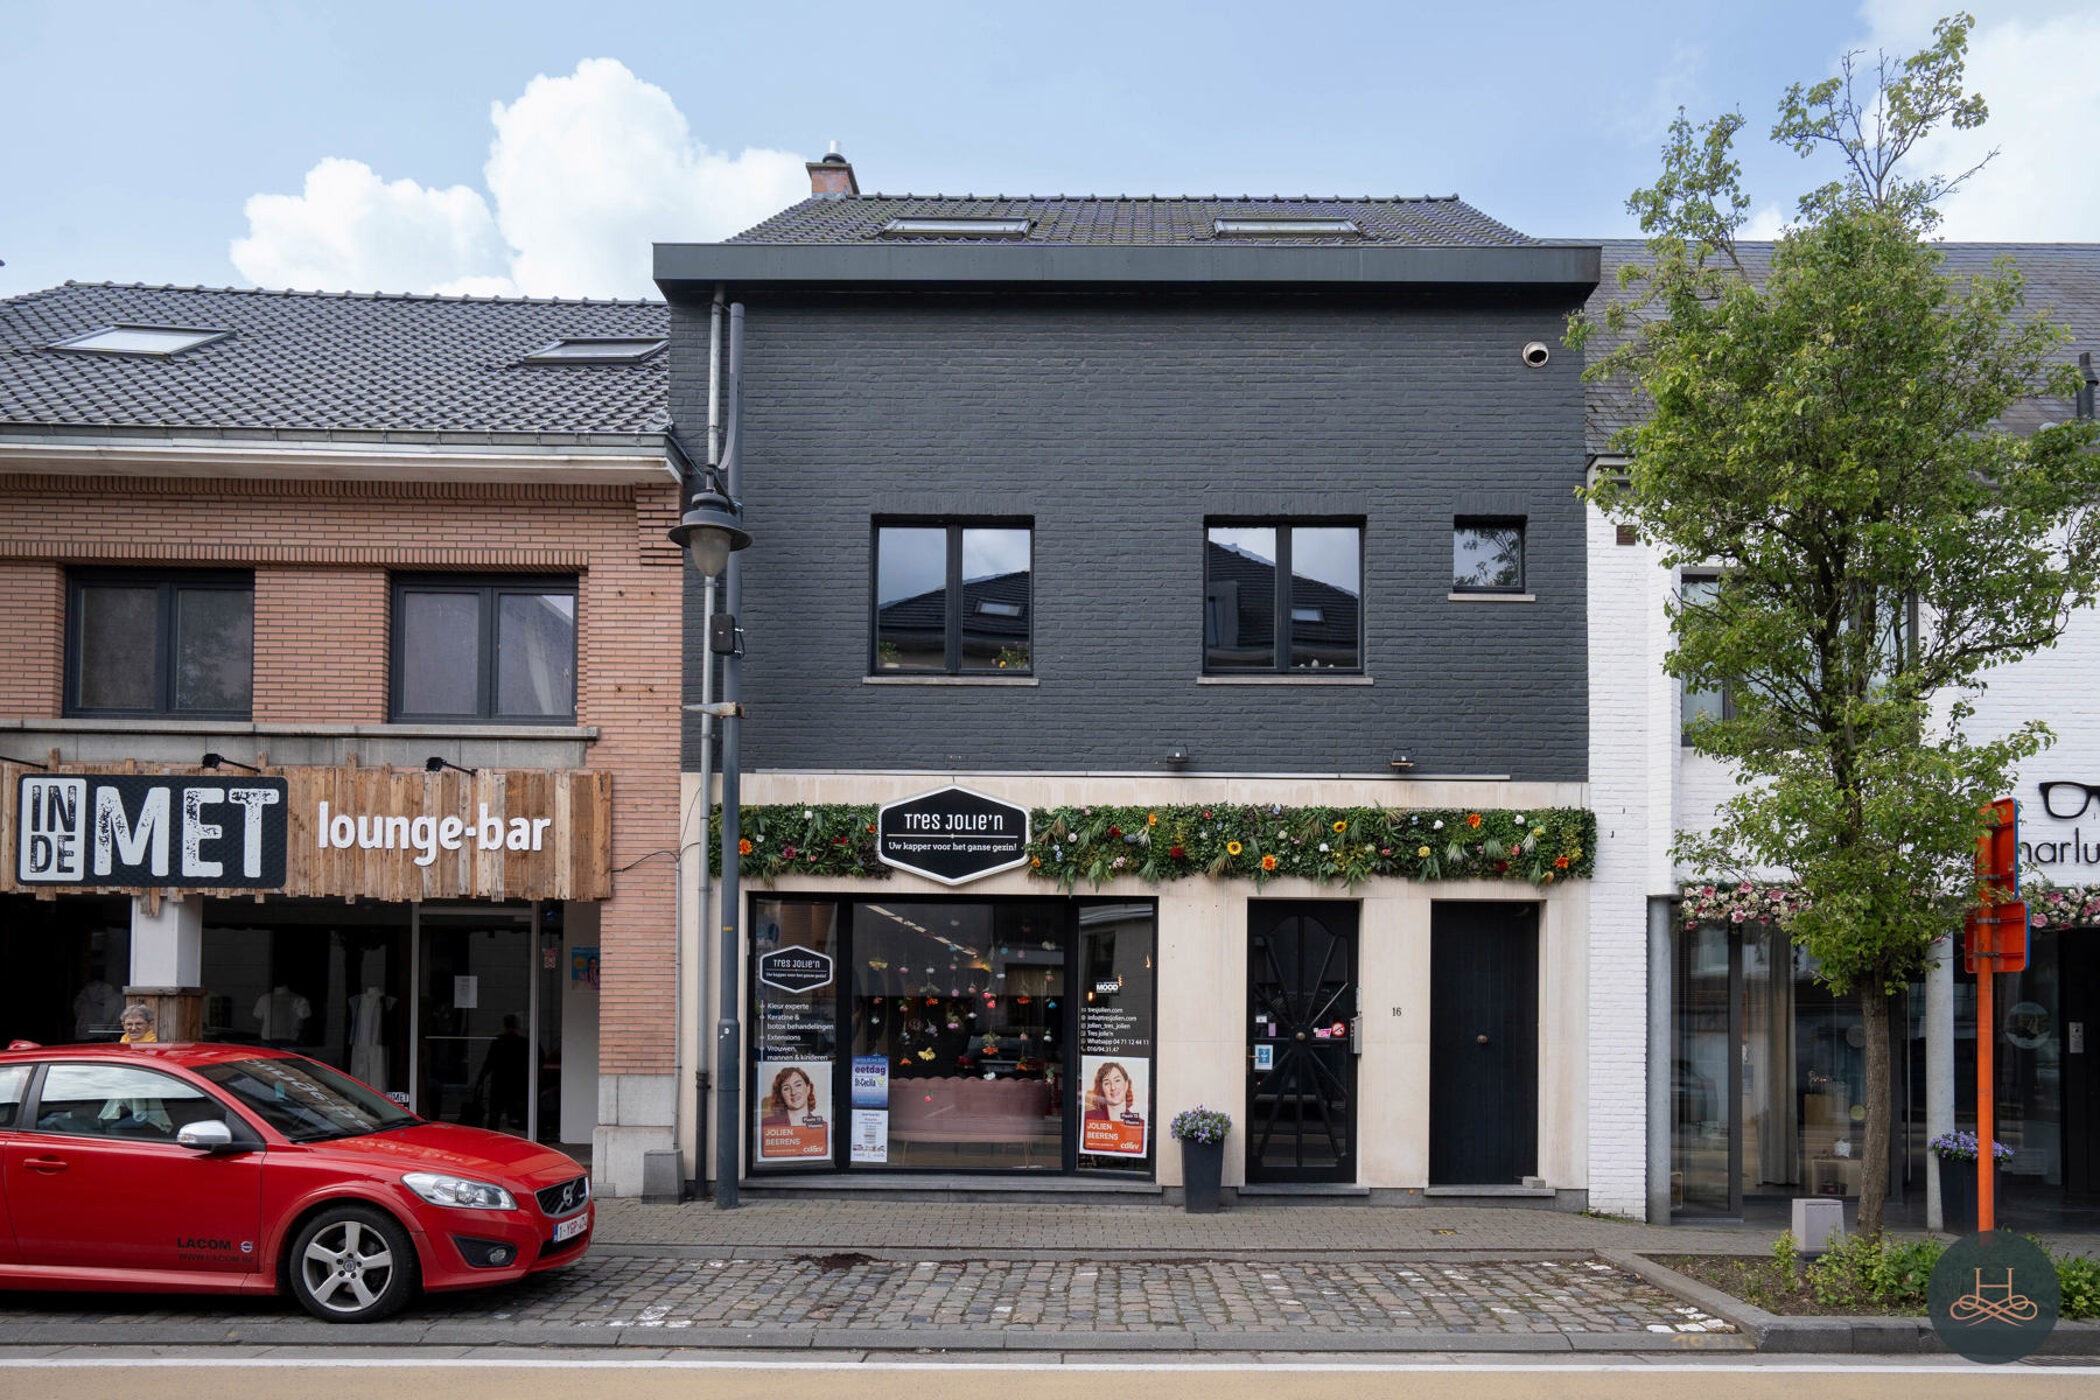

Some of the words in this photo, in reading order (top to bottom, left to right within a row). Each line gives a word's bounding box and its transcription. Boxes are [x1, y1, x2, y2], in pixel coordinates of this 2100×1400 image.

[31, 785, 77, 832] IN
[94, 786, 280, 878] MET
[318, 801, 552, 867] lounge-bar
[888, 842, 902, 850] Uw
[903, 842, 931, 852] kapper
[932, 843, 951, 851] voor
[952, 842, 966, 851] het
[967, 844, 991, 853] ganse
[992, 843, 1017, 853] gezin!
[29, 834, 75, 874] DE
[767, 1002, 784, 1010] Kleur
[1392, 1007, 1402, 1017] 16
[787, 1023, 834, 1031] behandelingen
[855, 1065, 886, 1076] eetdag
[1087, 1122, 1112, 1130] JOLIEN
[765, 1128, 793, 1136] JOLIEN
[1087, 1131, 1118, 1140] BEERENS
[177, 1237, 232, 1250] LACOM
